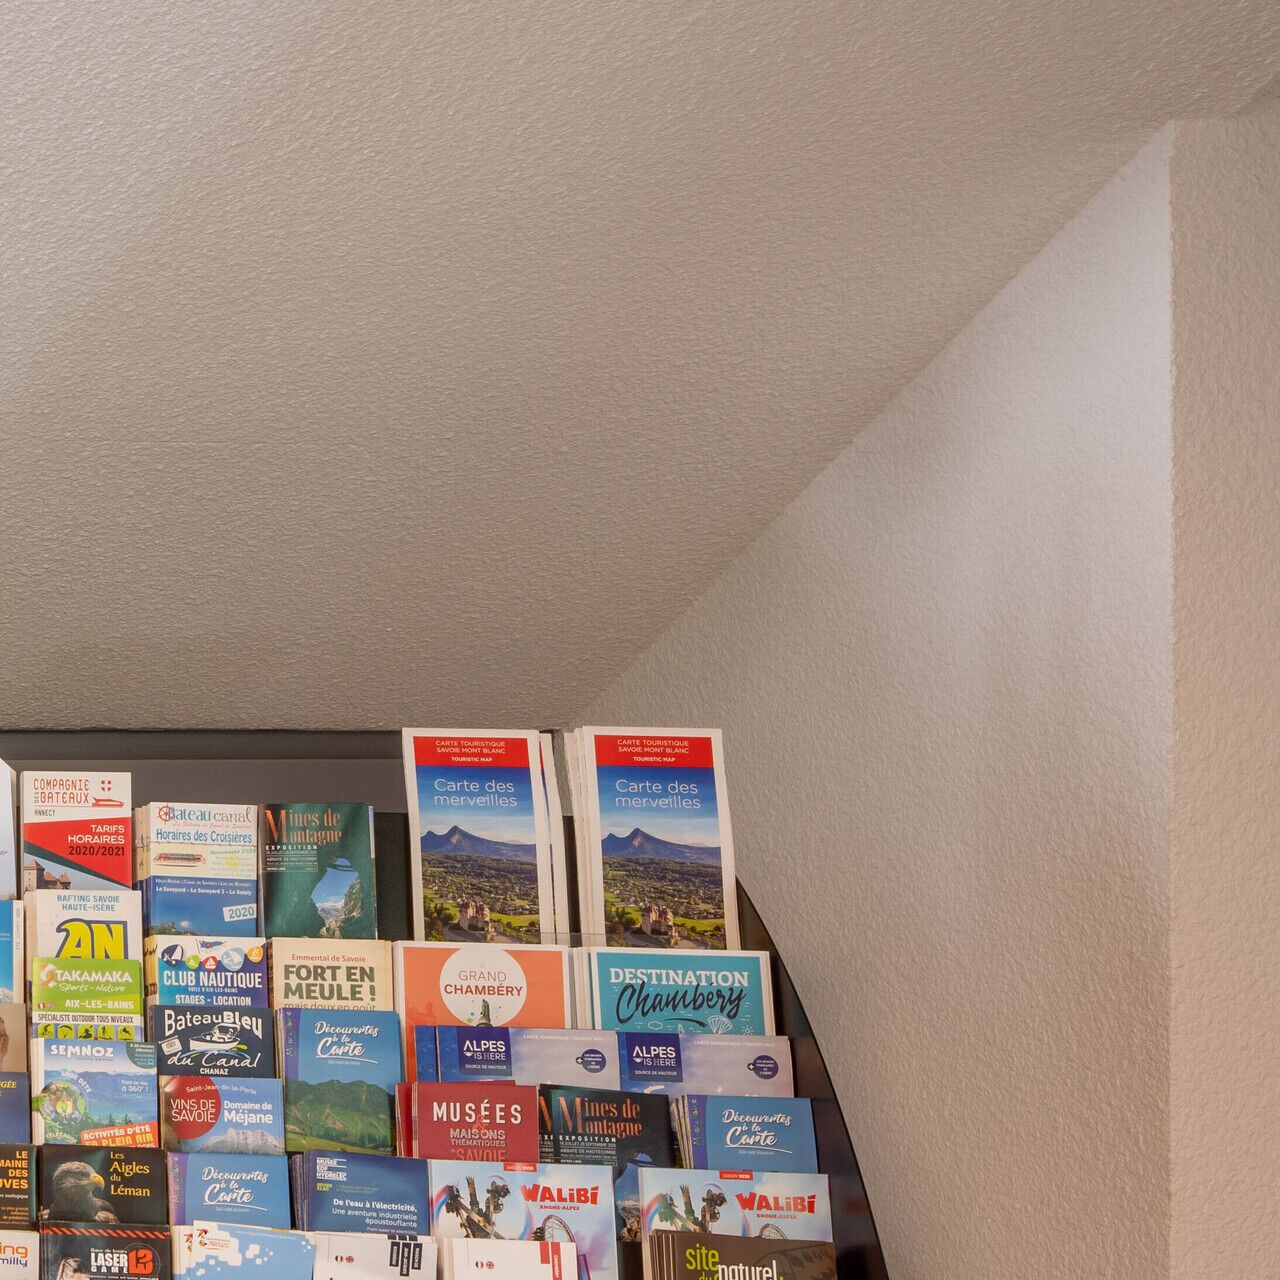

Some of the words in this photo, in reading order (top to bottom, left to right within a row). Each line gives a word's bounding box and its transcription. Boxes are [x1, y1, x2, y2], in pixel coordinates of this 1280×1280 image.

[34, 779, 90, 791] COMPAGNIE
[434, 779, 480, 792] Carte
[485, 780, 515, 792] des
[616, 779, 662, 793] Carte
[668, 780, 698, 794] des
[40, 792, 90, 804] BATEAUX
[434, 794, 518, 807] merveilles
[616, 795, 701, 810] merveilles
[91, 825, 125, 834] TARIFS
[68, 835, 125, 844] HORAIRES
[156, 829, 192, 842] Horaires
[194, 830, 208, 842] des
[210, 831, 253, 844] Croisières
[68, 846, 125, 857] 2020/2021
[57, 895, 90, 903] RAFTING
[93, 895, 120, 903] SAVOIE
[228, 906, 255, 919] 2020
[57, 969, 132, 982] TAKAMAKA
[163, 970, 196, 986] CLUB
[199, 971, 263, 988] NAUTIQUE
[284, 964, 342, 982] FORT
[346, 966, 375, 983] EN
[458, 970, 507, 982] GRAND
[610, 968, 749, 987] DESTINATION
[444, 983, 523, 997] CHAMBÉRY
[65, 1000, 134, 1009] AIX-LES-BAINS
[175, 994, 205, 1005] STAGES
[213, 995, 252, 1006] LOCATION
[616, 981, 747, 1025] Chambéry
[314, 1021, 380, 1036] Découvertes
[51, 1044, 114, 1058] SEMNOZ
[316, 1038, 366, 1057] Carte
[463, 1039, 506, 1052] ALPES
[167, 1052, 195, 1065] du
[202, 1051, 262, 1068] Canal
[200, 1067, 229, 1075] CHANAZ
[186, 1086, 257, 1095] Saint-Jean-de-la-Porte
[171, 1099, 196, 1110] VINS
[199, 1100, 216, 1110] DE
[224, 1101, 260, 1110] Domaine
[262, 1102, 273, 1111] de
[171, 1110, 216, 1122] SAVOIE
[224, 1111, 273, 1125] Méjane
[432, 1099, 522, 1125] MUSÉES
[83, 1128, 125, 1140] ACTIVITÉS
[127, 1124, 151, 1133] D'ÉTÉ
[450, 1128, 506, 1140] MAISONS
[16, 1151, 28, 1159] LE
[110, 1151, 124, 1159] Les
[8, 1169, 28, 1178] DES
[110, 1161, 150, 1175] Aigles
[110, 1173, 121, 1181] du
[110, 1184, 150, 1197] Léman
[379, 1211, 417, 1221] industrielle
[91, 1253, 128, 1267] LASER
[686, 1244, 719, 1271] site
[91, 1266, 128, 1274] GAME
